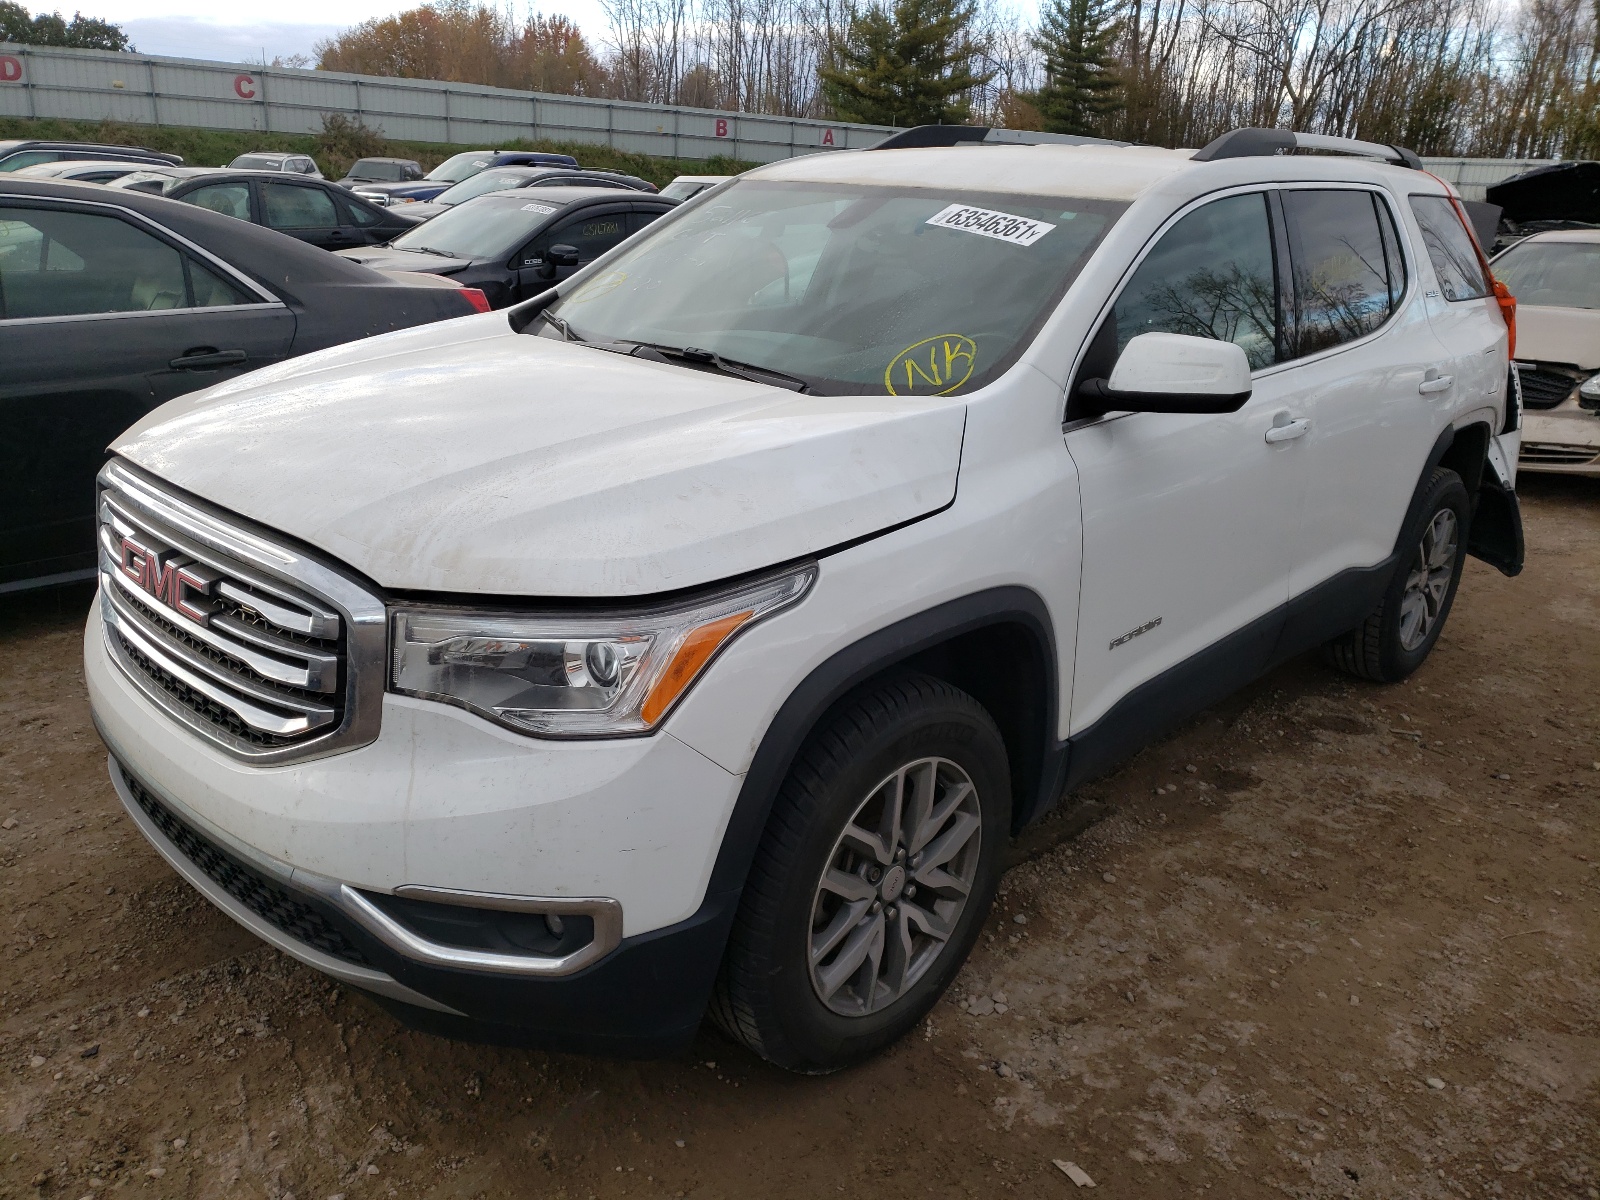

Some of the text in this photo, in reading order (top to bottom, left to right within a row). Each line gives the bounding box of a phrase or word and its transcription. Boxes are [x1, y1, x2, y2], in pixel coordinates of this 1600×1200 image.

[0, 56, 22, 81] D
[234, 75, 255, 98] C
[715, 119, 728, 137] B
[822, 128, 834, 145] A
[121, 536, 209, 627] GMC
[1109, 615, 1162, 651] ACADIA
